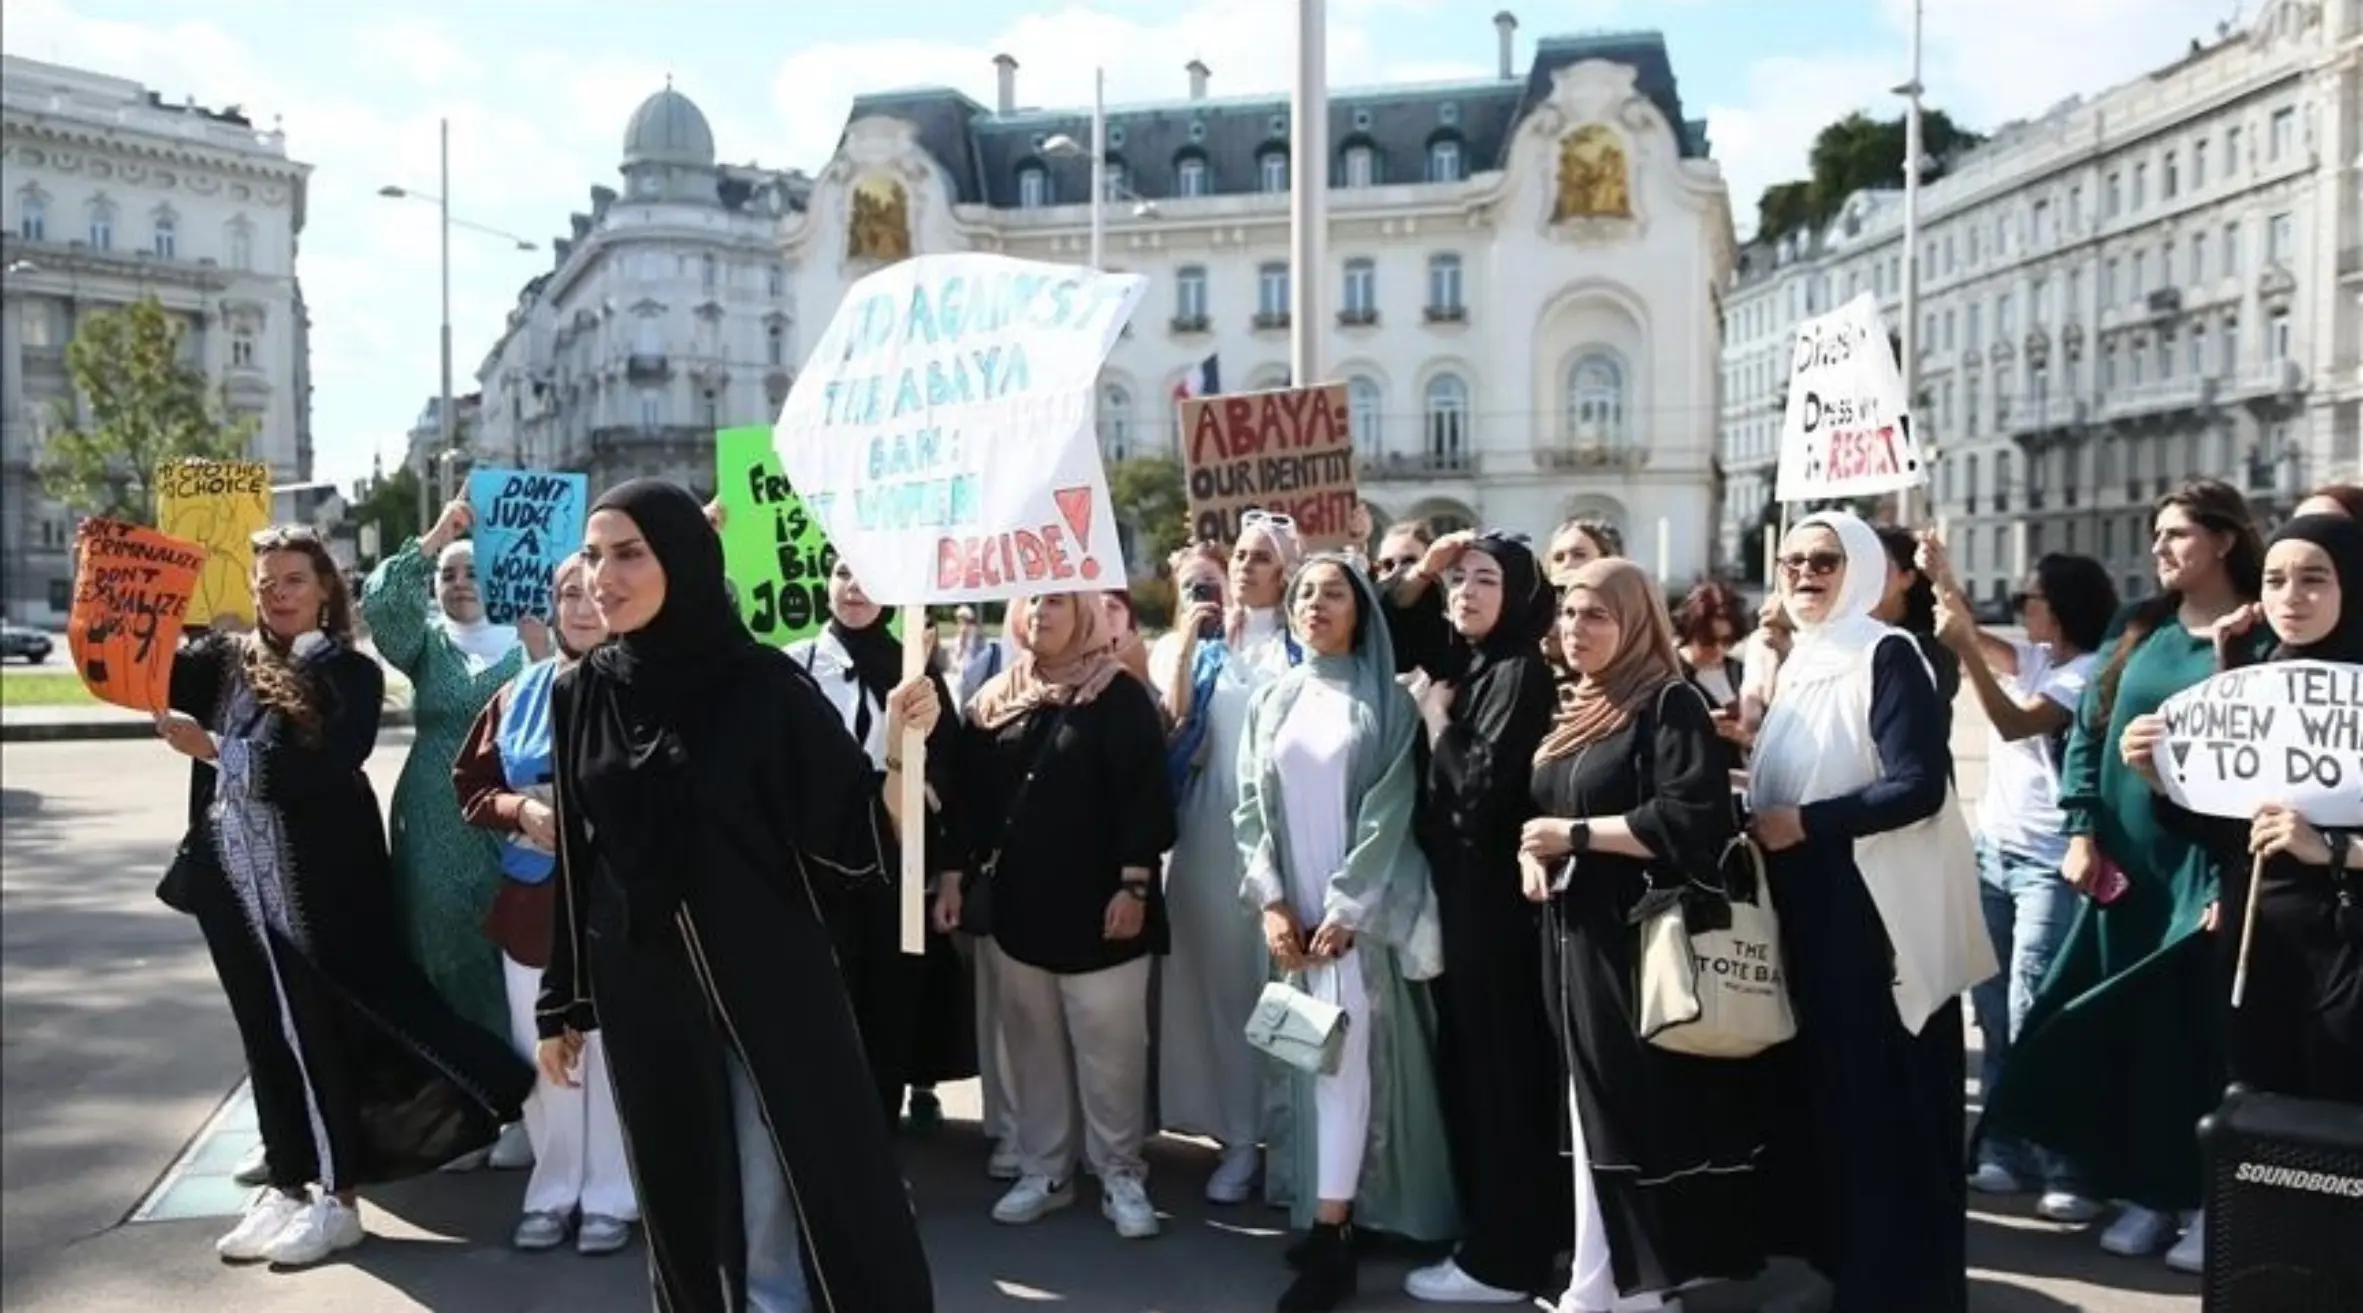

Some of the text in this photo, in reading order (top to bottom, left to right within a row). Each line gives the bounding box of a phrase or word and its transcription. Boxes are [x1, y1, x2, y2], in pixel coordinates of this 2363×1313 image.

[823, 343, 1029, 425] THE ABAYA
[1192, 388, 1349, 465] ABAYA:
[178, 477, 262, 498] CHOICE
[1191, 460, 1257, 500] OUR
[508, 528, 541, 556] A
[936, 485, 1102, 591] DECIDE!
[1197, 503, 1264, 546] OU
[491, 555, 554, 586] WOMA
[2165, 701, 2363, 751] WOMEN WH
[2206, 741, 2261, 781] TO
[2285, 746, 2343, 789] DO
[1693, 954, 1782, 986] TOTE BA
[1732, 940, 1768, 961] THE
[2235, 1161, 2363, 1197] SOUNDBOKS
